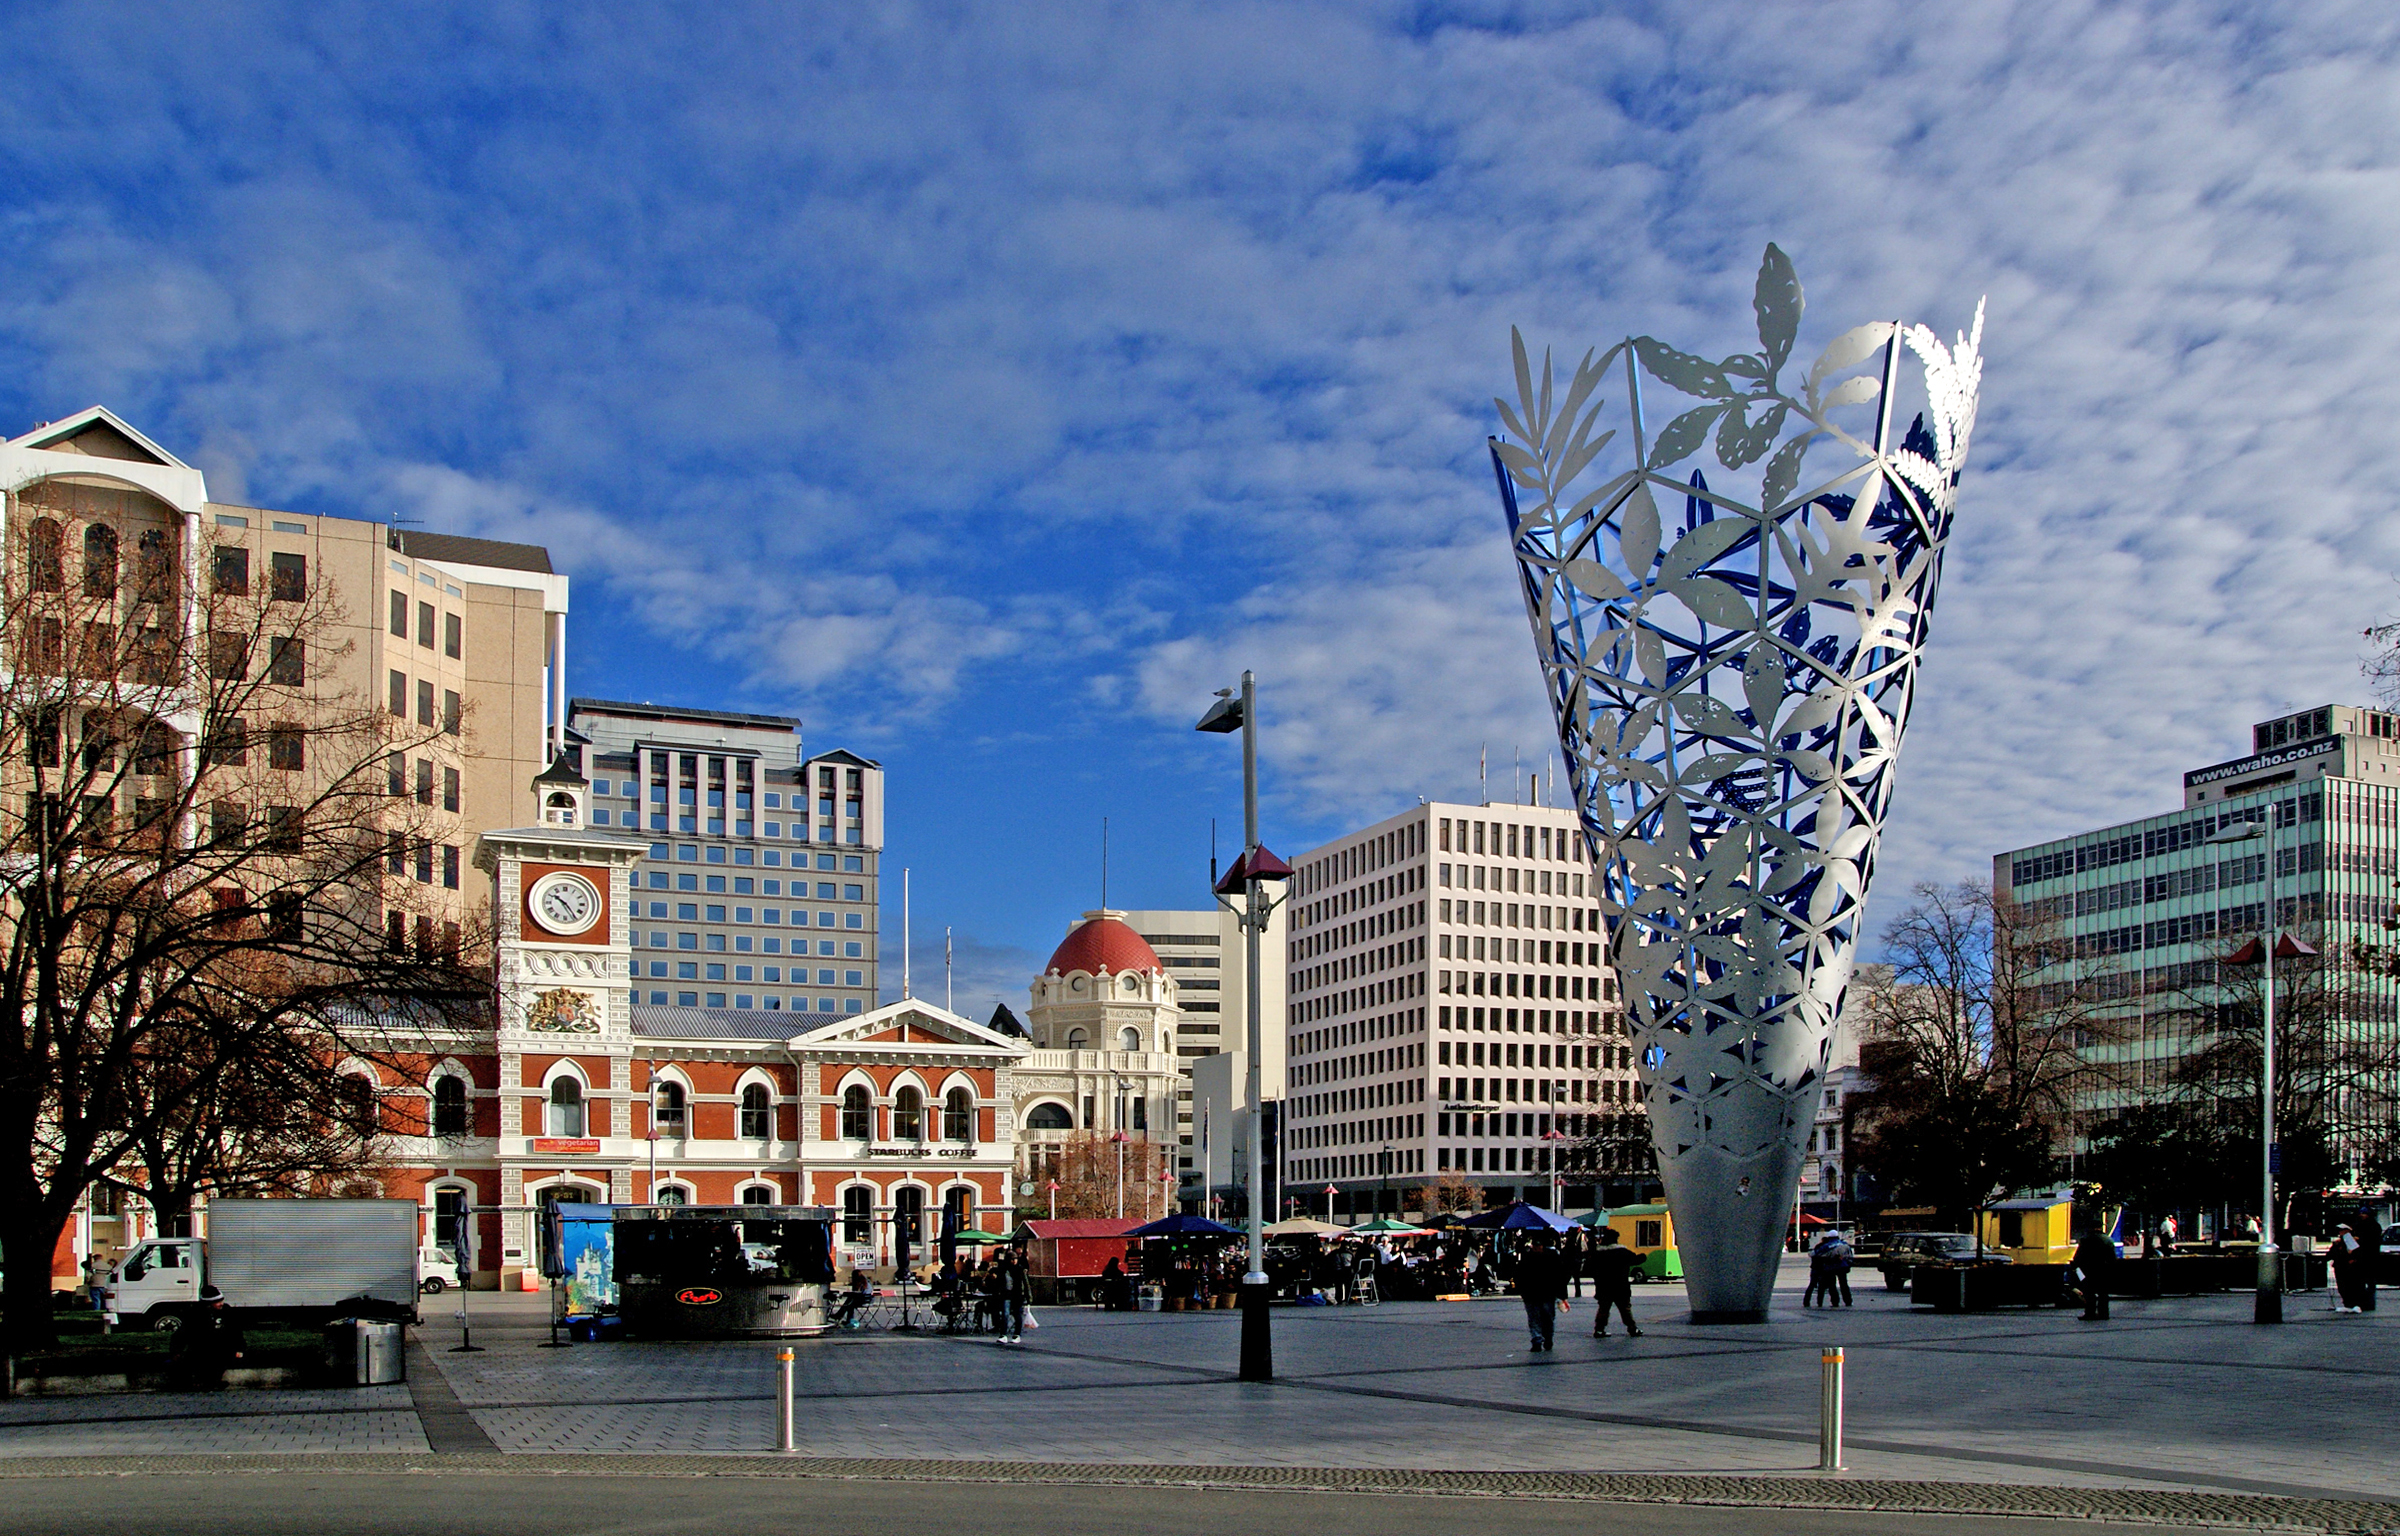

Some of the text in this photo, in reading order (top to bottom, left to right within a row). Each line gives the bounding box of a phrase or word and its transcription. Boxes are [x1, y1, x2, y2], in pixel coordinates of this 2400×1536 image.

[2191, 740, 2334, 785] www.waho.co.nz
[867, 1148, 978, 1157] STARBUCKS COFFEE
[856, 1252, 874, 1260] OPEN
